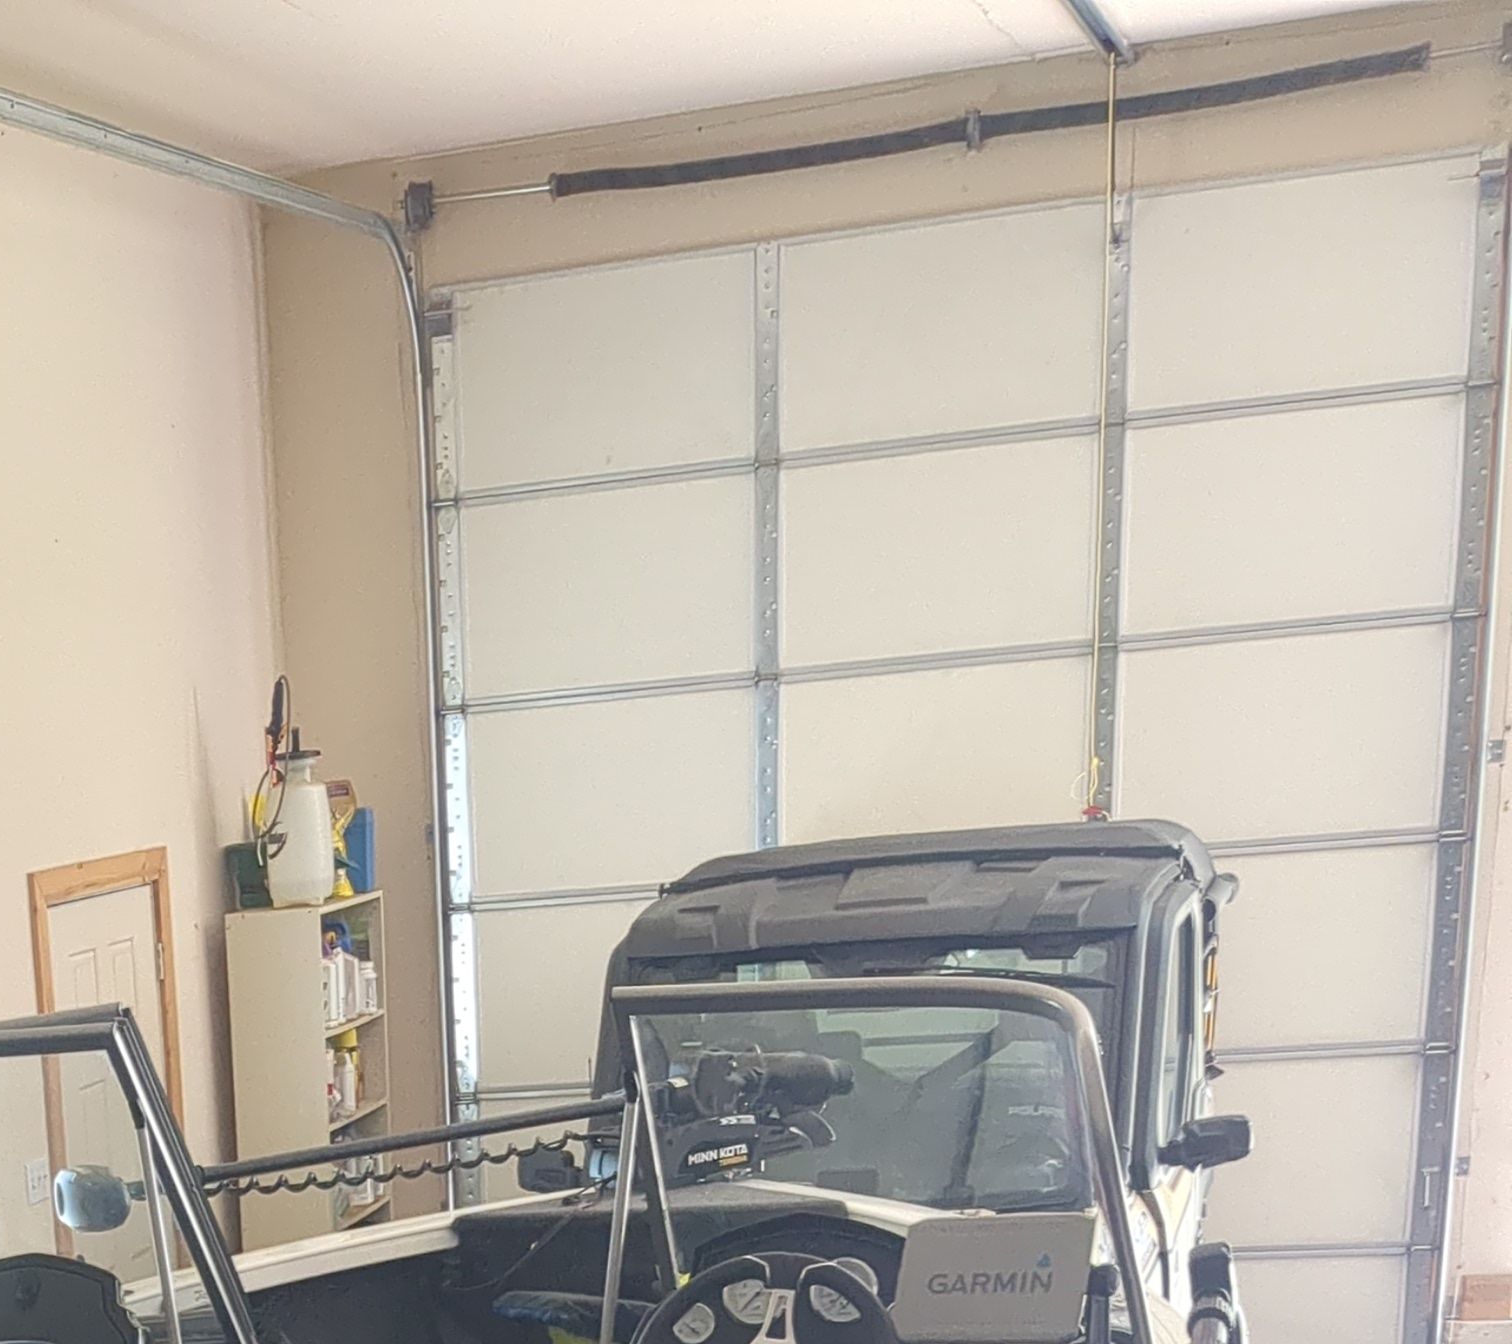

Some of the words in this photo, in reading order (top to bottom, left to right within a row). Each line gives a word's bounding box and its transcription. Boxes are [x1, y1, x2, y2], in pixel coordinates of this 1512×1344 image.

[687, 1148, 718, 1167] MINN
[719, 1143, 749, 1159] KOTA
[927, 1270, 1054, 1295] GARMIN
